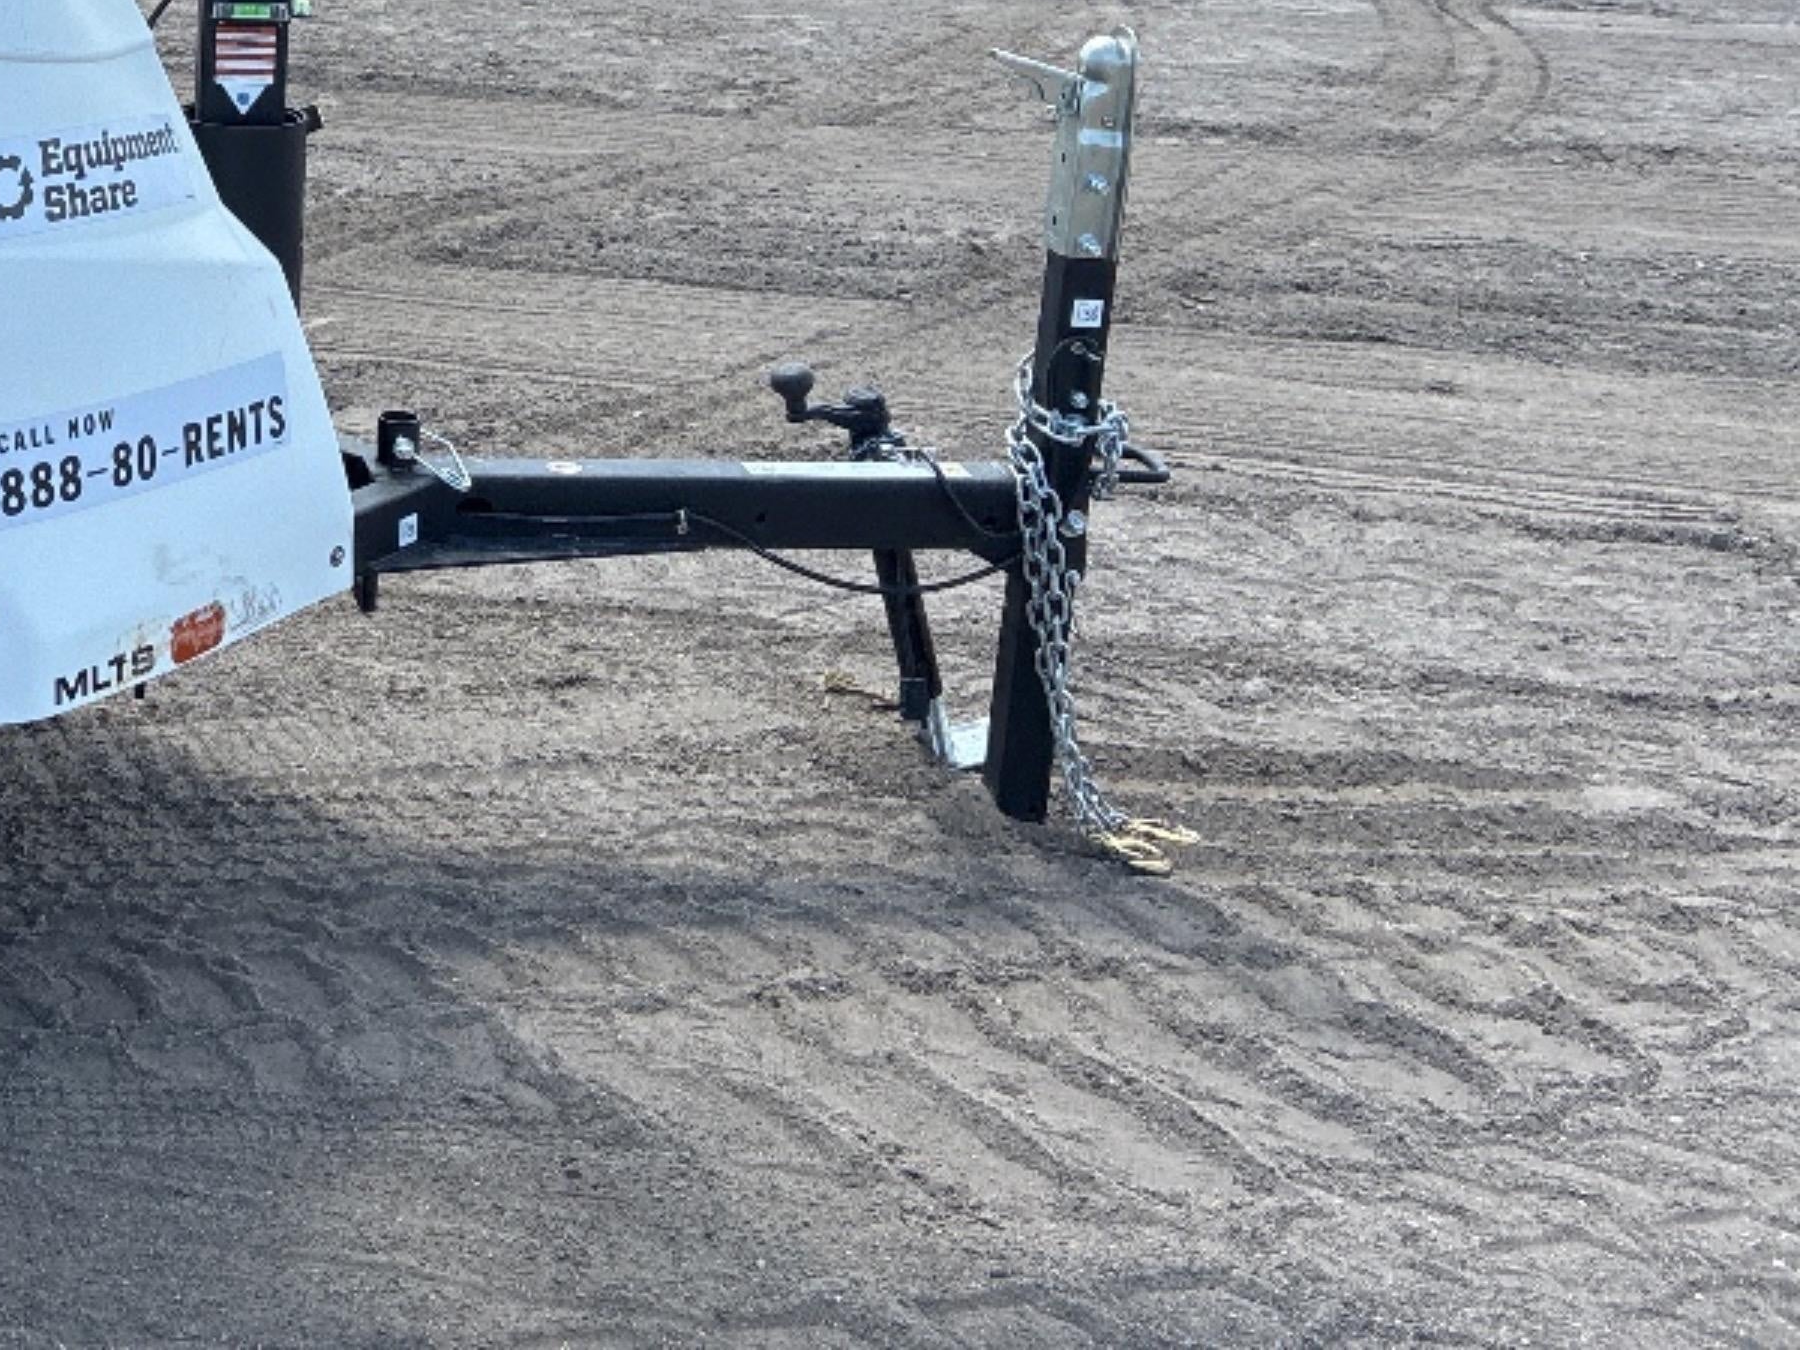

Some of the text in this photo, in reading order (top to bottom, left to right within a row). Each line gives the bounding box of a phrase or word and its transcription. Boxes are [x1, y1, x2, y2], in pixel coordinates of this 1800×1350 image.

[38, 121, 178, 181] Equipment
[43, 178, 139, 223] Share
[67, 406, 116, 439] NOW
[0, 394, 288, 517] 888-80-RENTS
